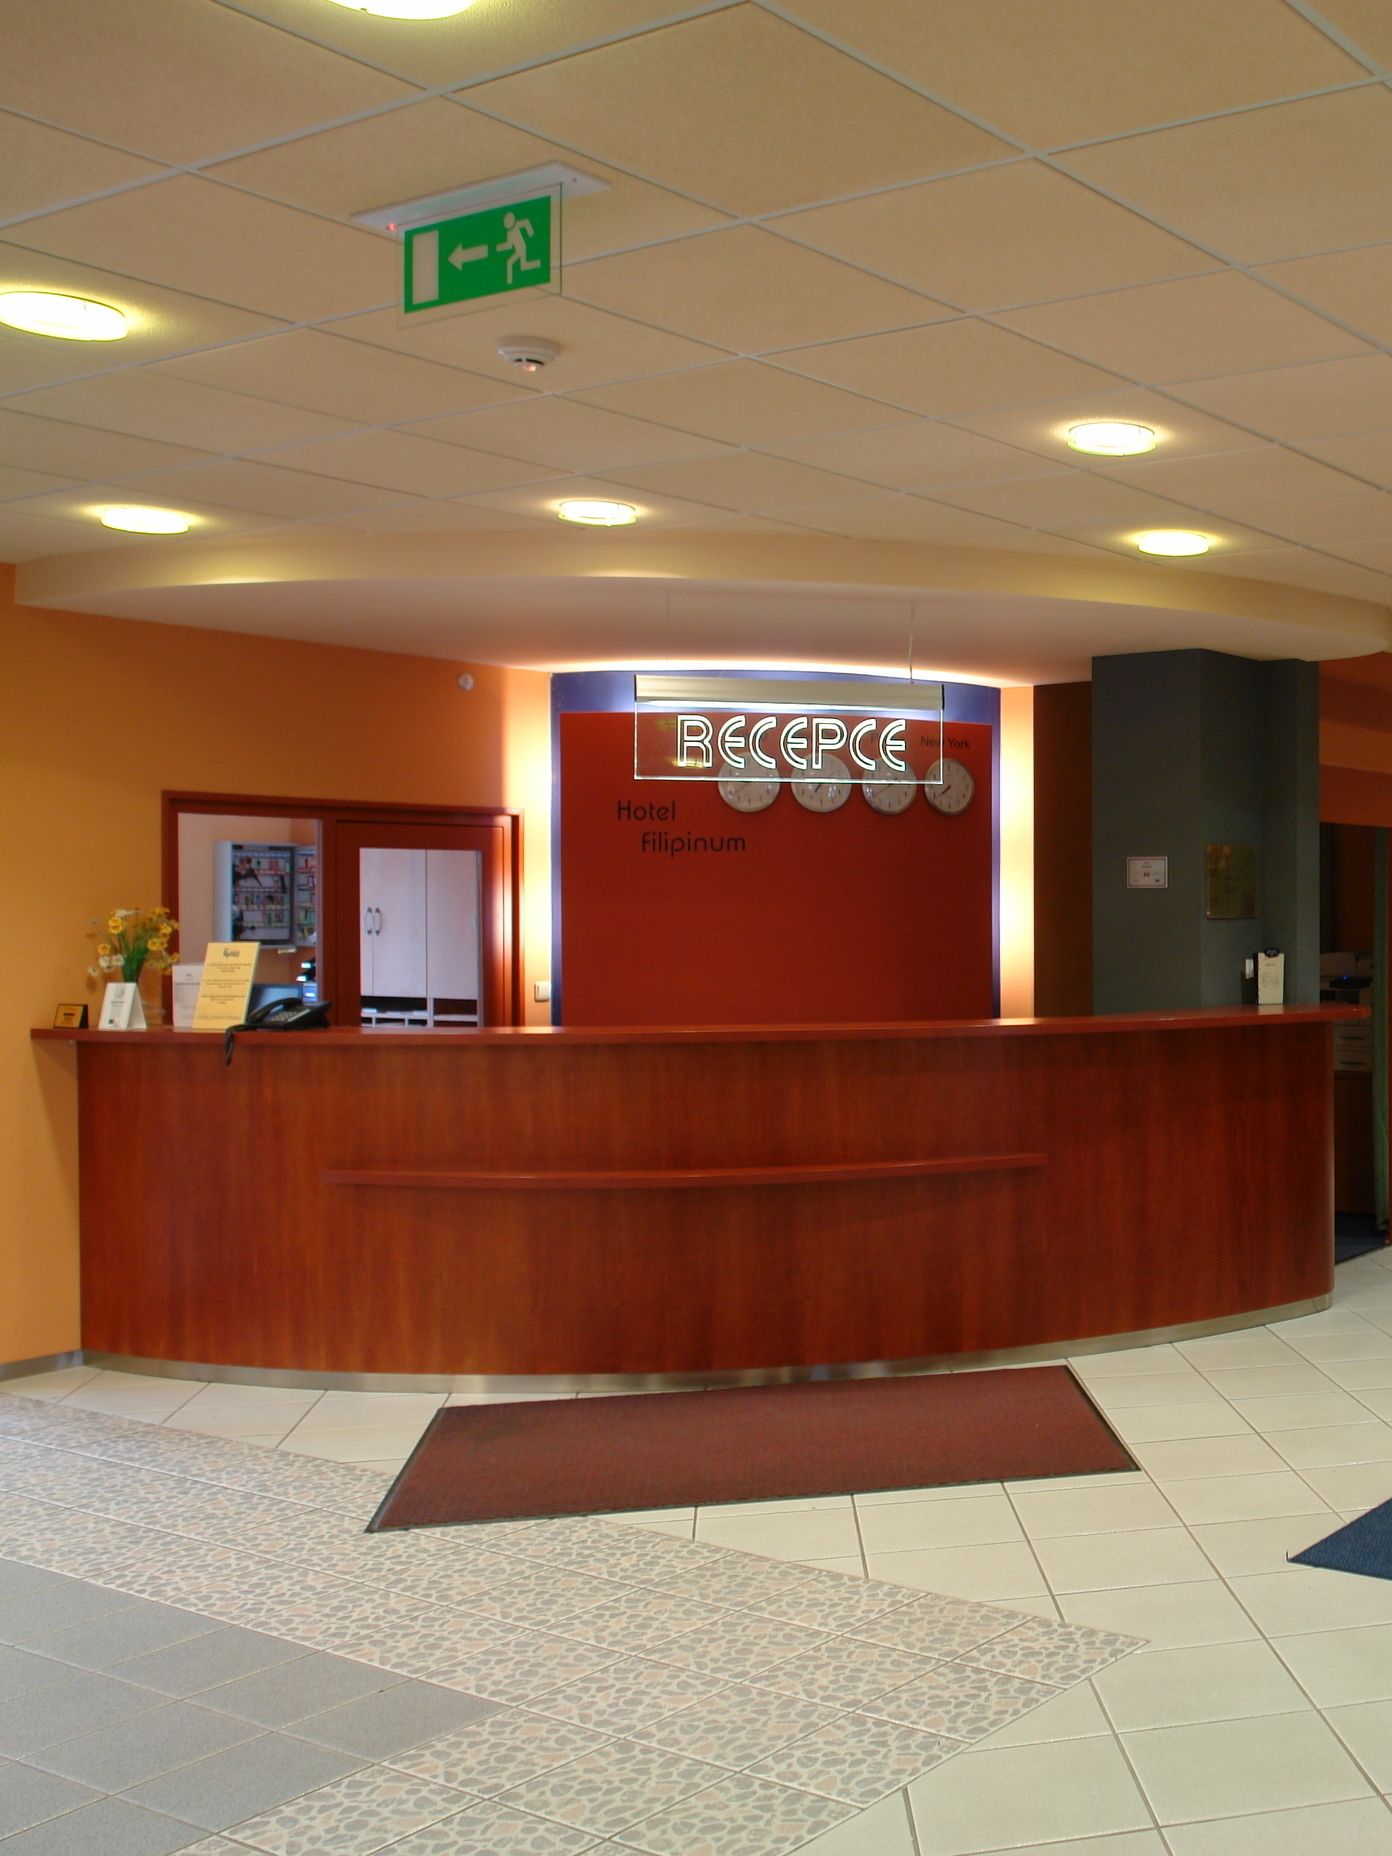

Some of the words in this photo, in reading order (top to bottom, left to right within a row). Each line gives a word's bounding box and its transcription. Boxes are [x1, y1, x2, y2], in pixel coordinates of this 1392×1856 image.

[676, 714, 907, 772] RECEPCE
[947, 736, 970, 750] York
[617, 800, 676, 821] Hotel
[641, 831, 747, 858] Filipinum
